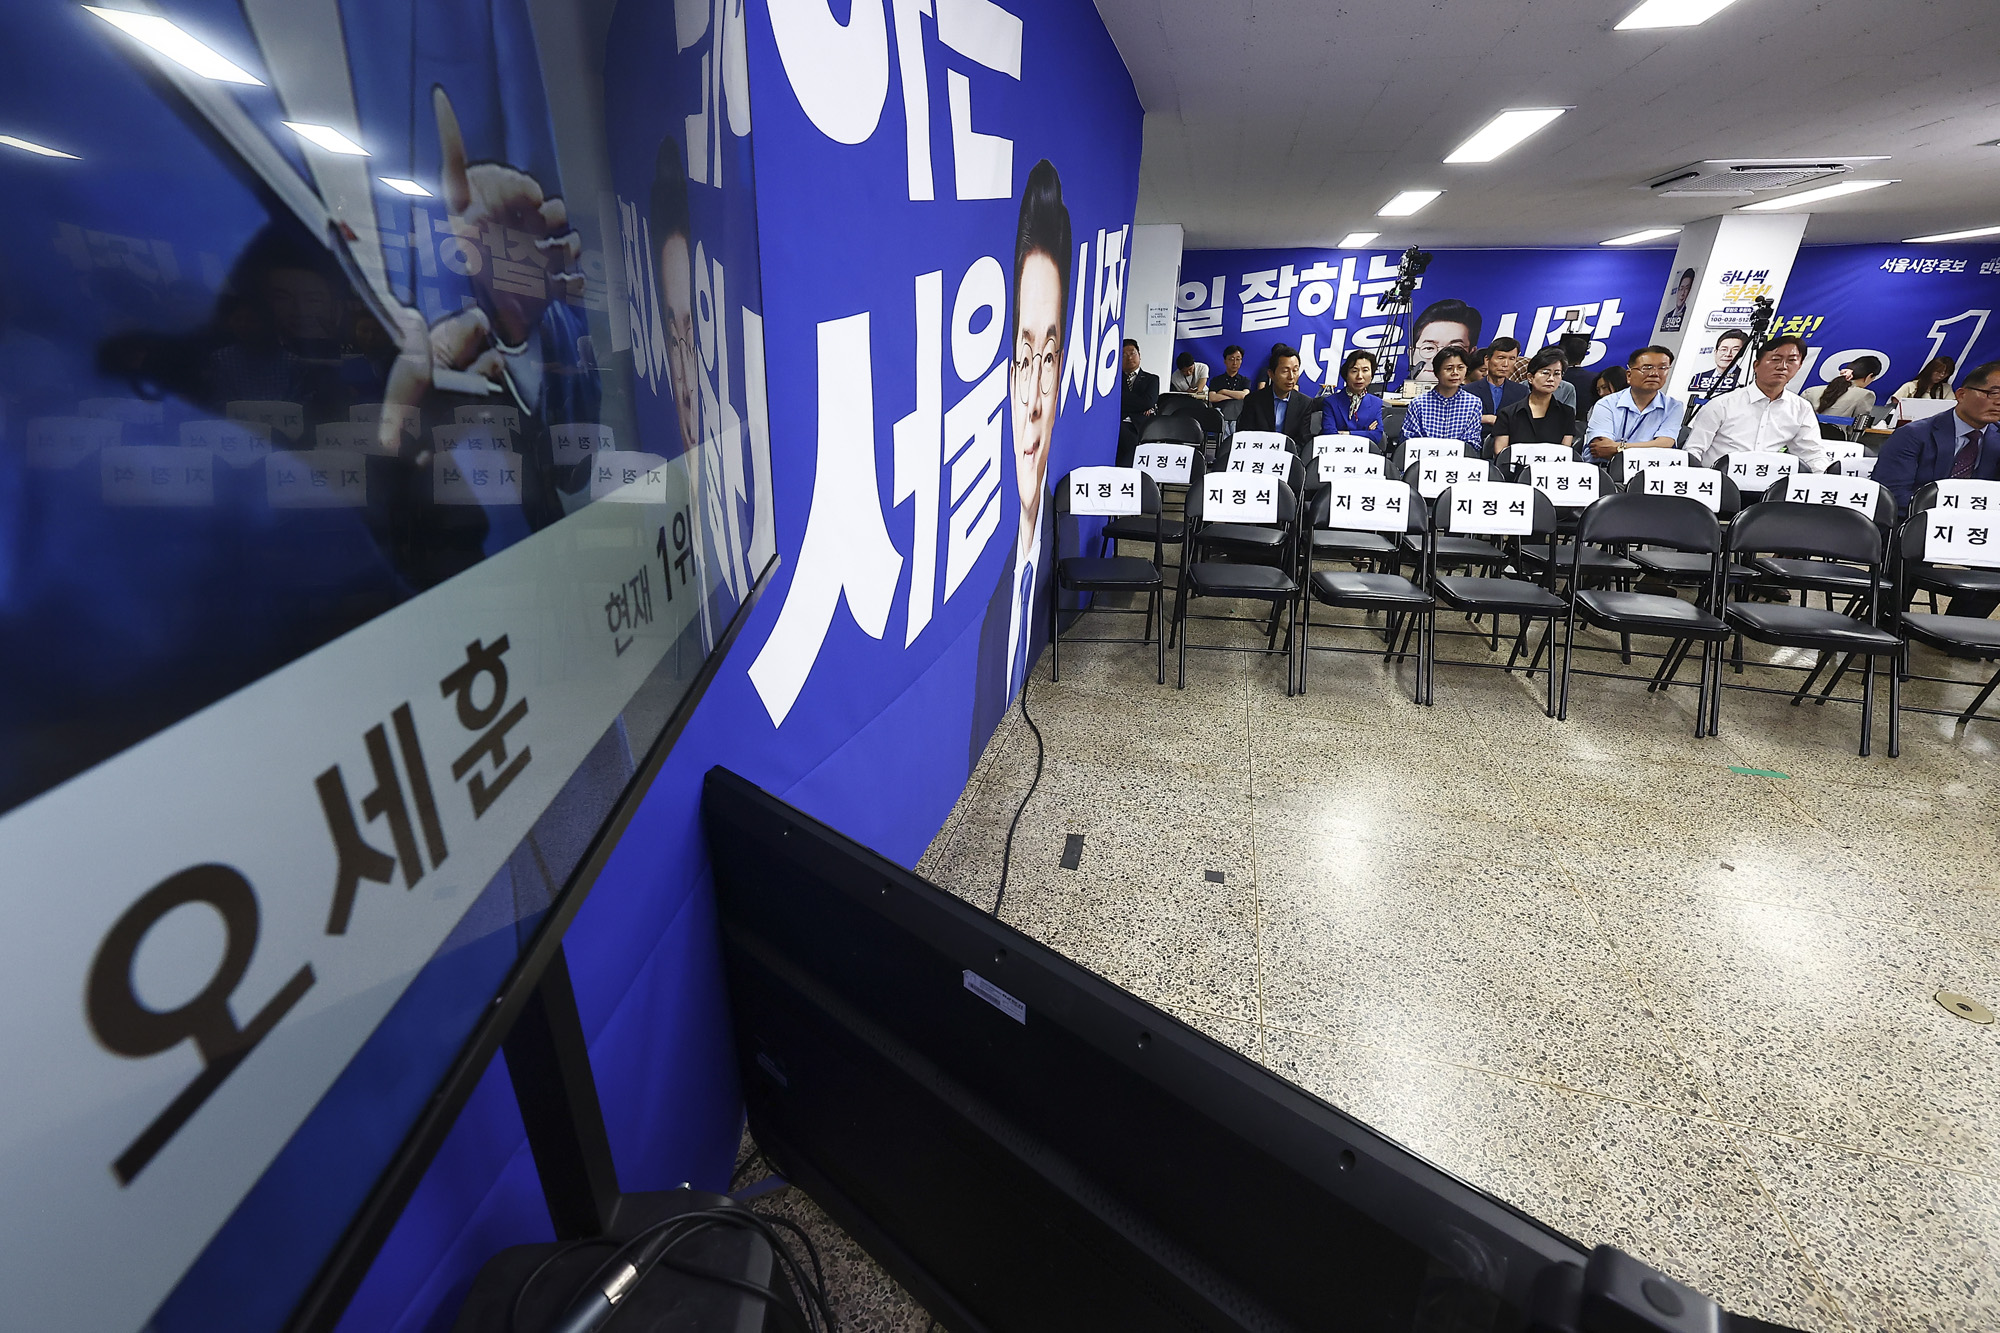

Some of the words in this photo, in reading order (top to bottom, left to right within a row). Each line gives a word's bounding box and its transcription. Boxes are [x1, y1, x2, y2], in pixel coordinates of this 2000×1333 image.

[1722, 269, 1769, 284] 하나씩
[1177, 275, 1226, 339] 일
[1239, 255, 1422, 333] 잘하는
[1725, 284, 1772, 302] 착착!
[1138, 455, 1186, 468] 지정석
[1232, 461, 1284, 474] 지정석
[748, 256, 1009, 729] 서울
[1060, 224, 1130, 415] 시장
[1424, 470, 1480, 483] 지정석
[1734, 464, 1791, 478] 지정석
[1076, 483, 1135, 498] 지정석
[1536, 476, 1592, 490] 지정석
[1650, 481, 1713, 496] 지정석
[1209, 489, 1270, 505] 지정석
[1336, 495, 1401, 513] 지정석
[1792, 489, 1869, 507] 지정석
[1943, 495, 2000, 510] 지정
[1457, 500, 1524, 515] 지정석
[605, 564, 655, 658] 현재
[657, 504, 697, 602] 1위
[84, 633, 532, 1188] 오세훈
